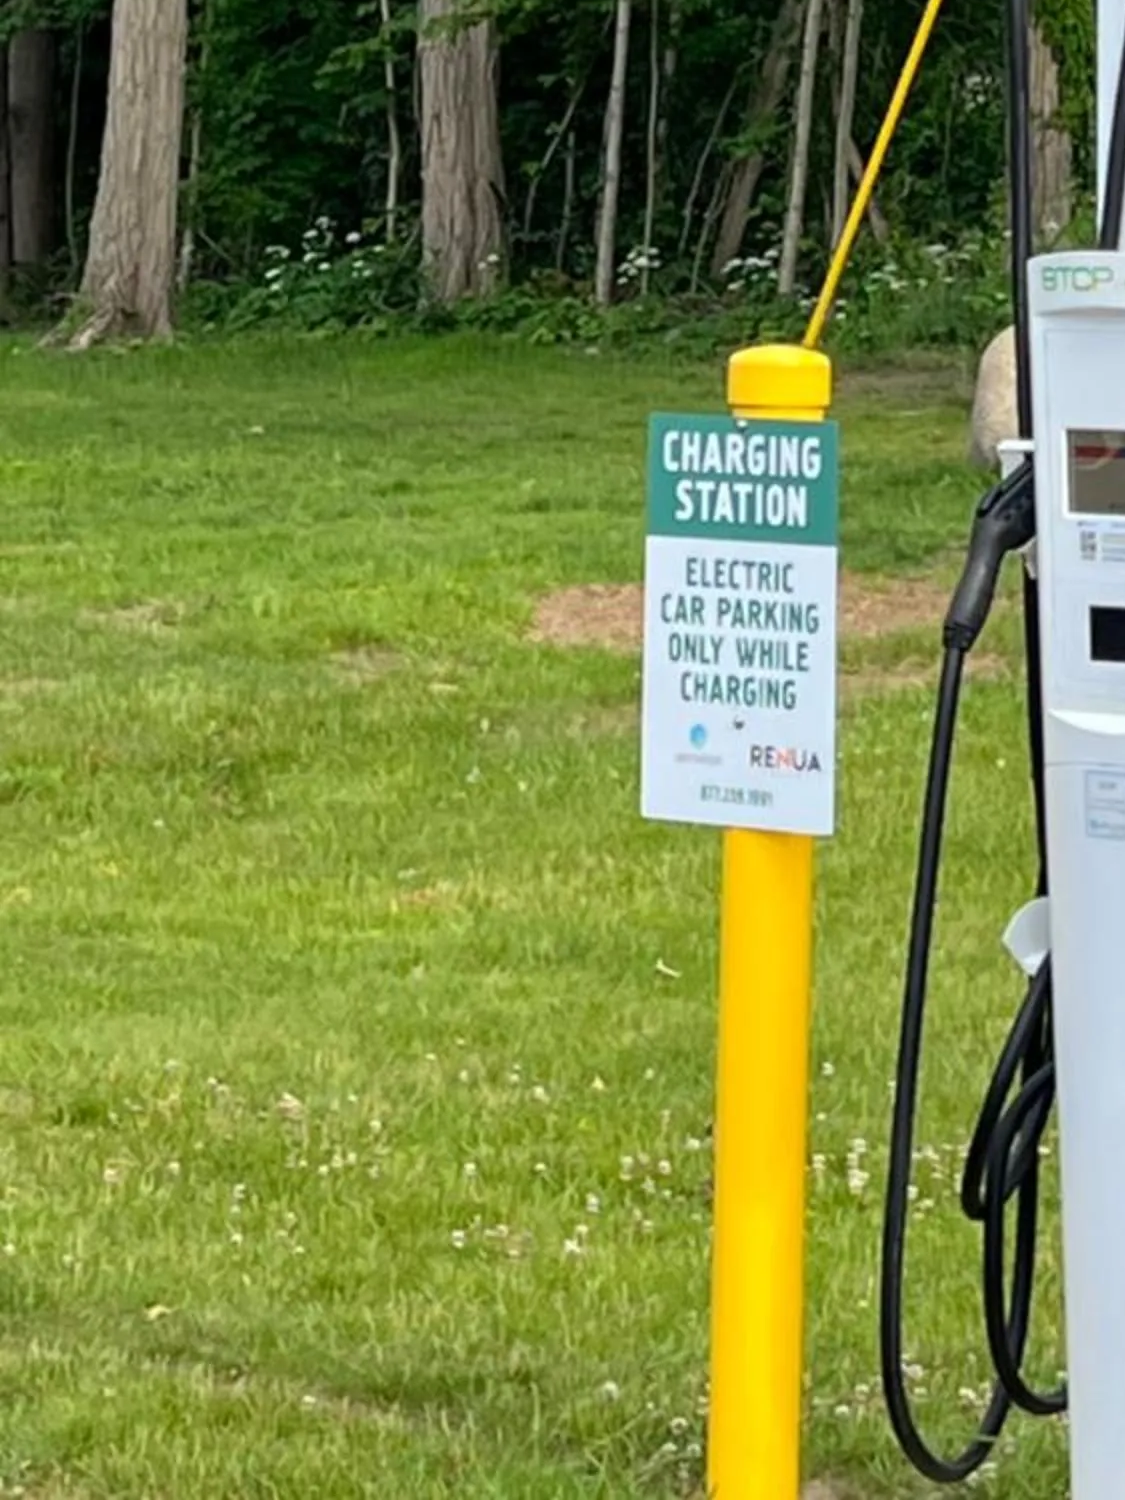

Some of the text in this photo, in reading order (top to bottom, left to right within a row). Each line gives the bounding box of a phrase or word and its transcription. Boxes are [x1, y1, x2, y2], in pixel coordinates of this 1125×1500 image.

[663, 430, 823, 479] CHARGING
[674, 480, 808, 528] STATION
[685, 557, 794, 593] ELECTRIC
[660, 594, 820, 634] CAR PARKING
[668, 633, 809, 672] ONLY WHILE
[681, 672, 797, 710] CHARGING
[750, 744, 822, 772] RENUA
